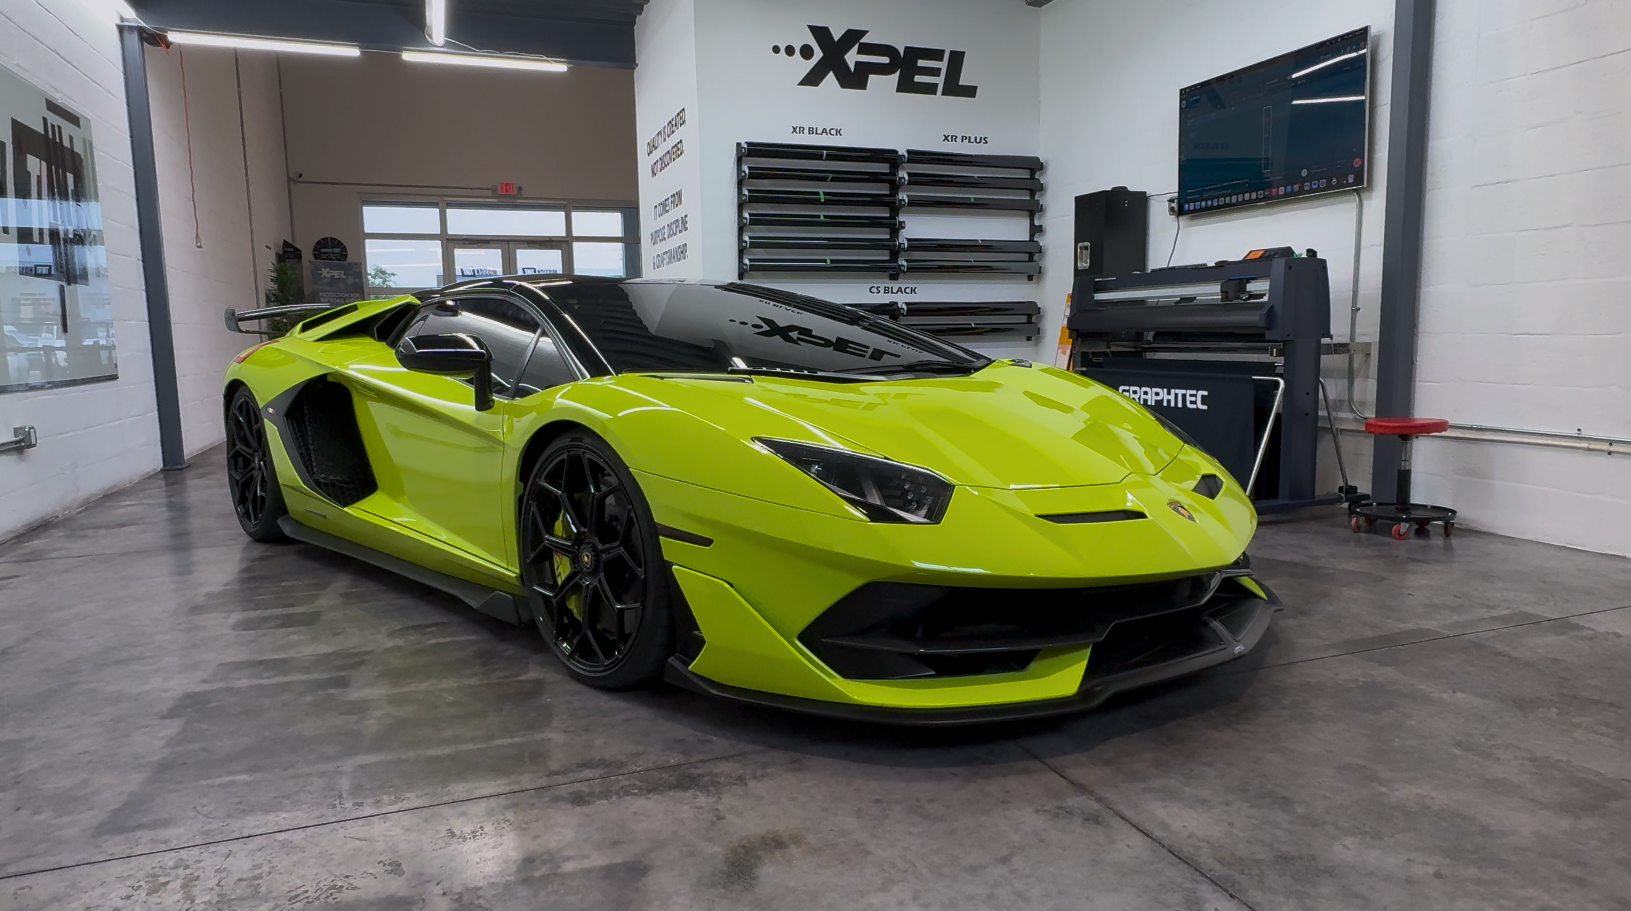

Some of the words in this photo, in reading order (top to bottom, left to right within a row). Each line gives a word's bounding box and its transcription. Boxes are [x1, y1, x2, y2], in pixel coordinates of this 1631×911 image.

[797, 24, 978, 98] XPEL
[647, 128, 663, 157] QUALITY
[791, 126, 805, 135] XR
[808, 126, 843, 137] BLACK
[942, 134, 958, 143] XR
[960, 135, 989, 145] PLUS
[650, 158, 659, 179] NOT
[658, 196, 670, 218] COMES
[670, 188, 682, 211] FROM
[667, 214, 688, 239] DISCIPLINE
[320, 267, 347, 278] XPEL
[869, 285, 881, 294] CS
[883, 286, 918, 295] BLACK
[1118, 385, 1208, 410] GRAPHTEC
